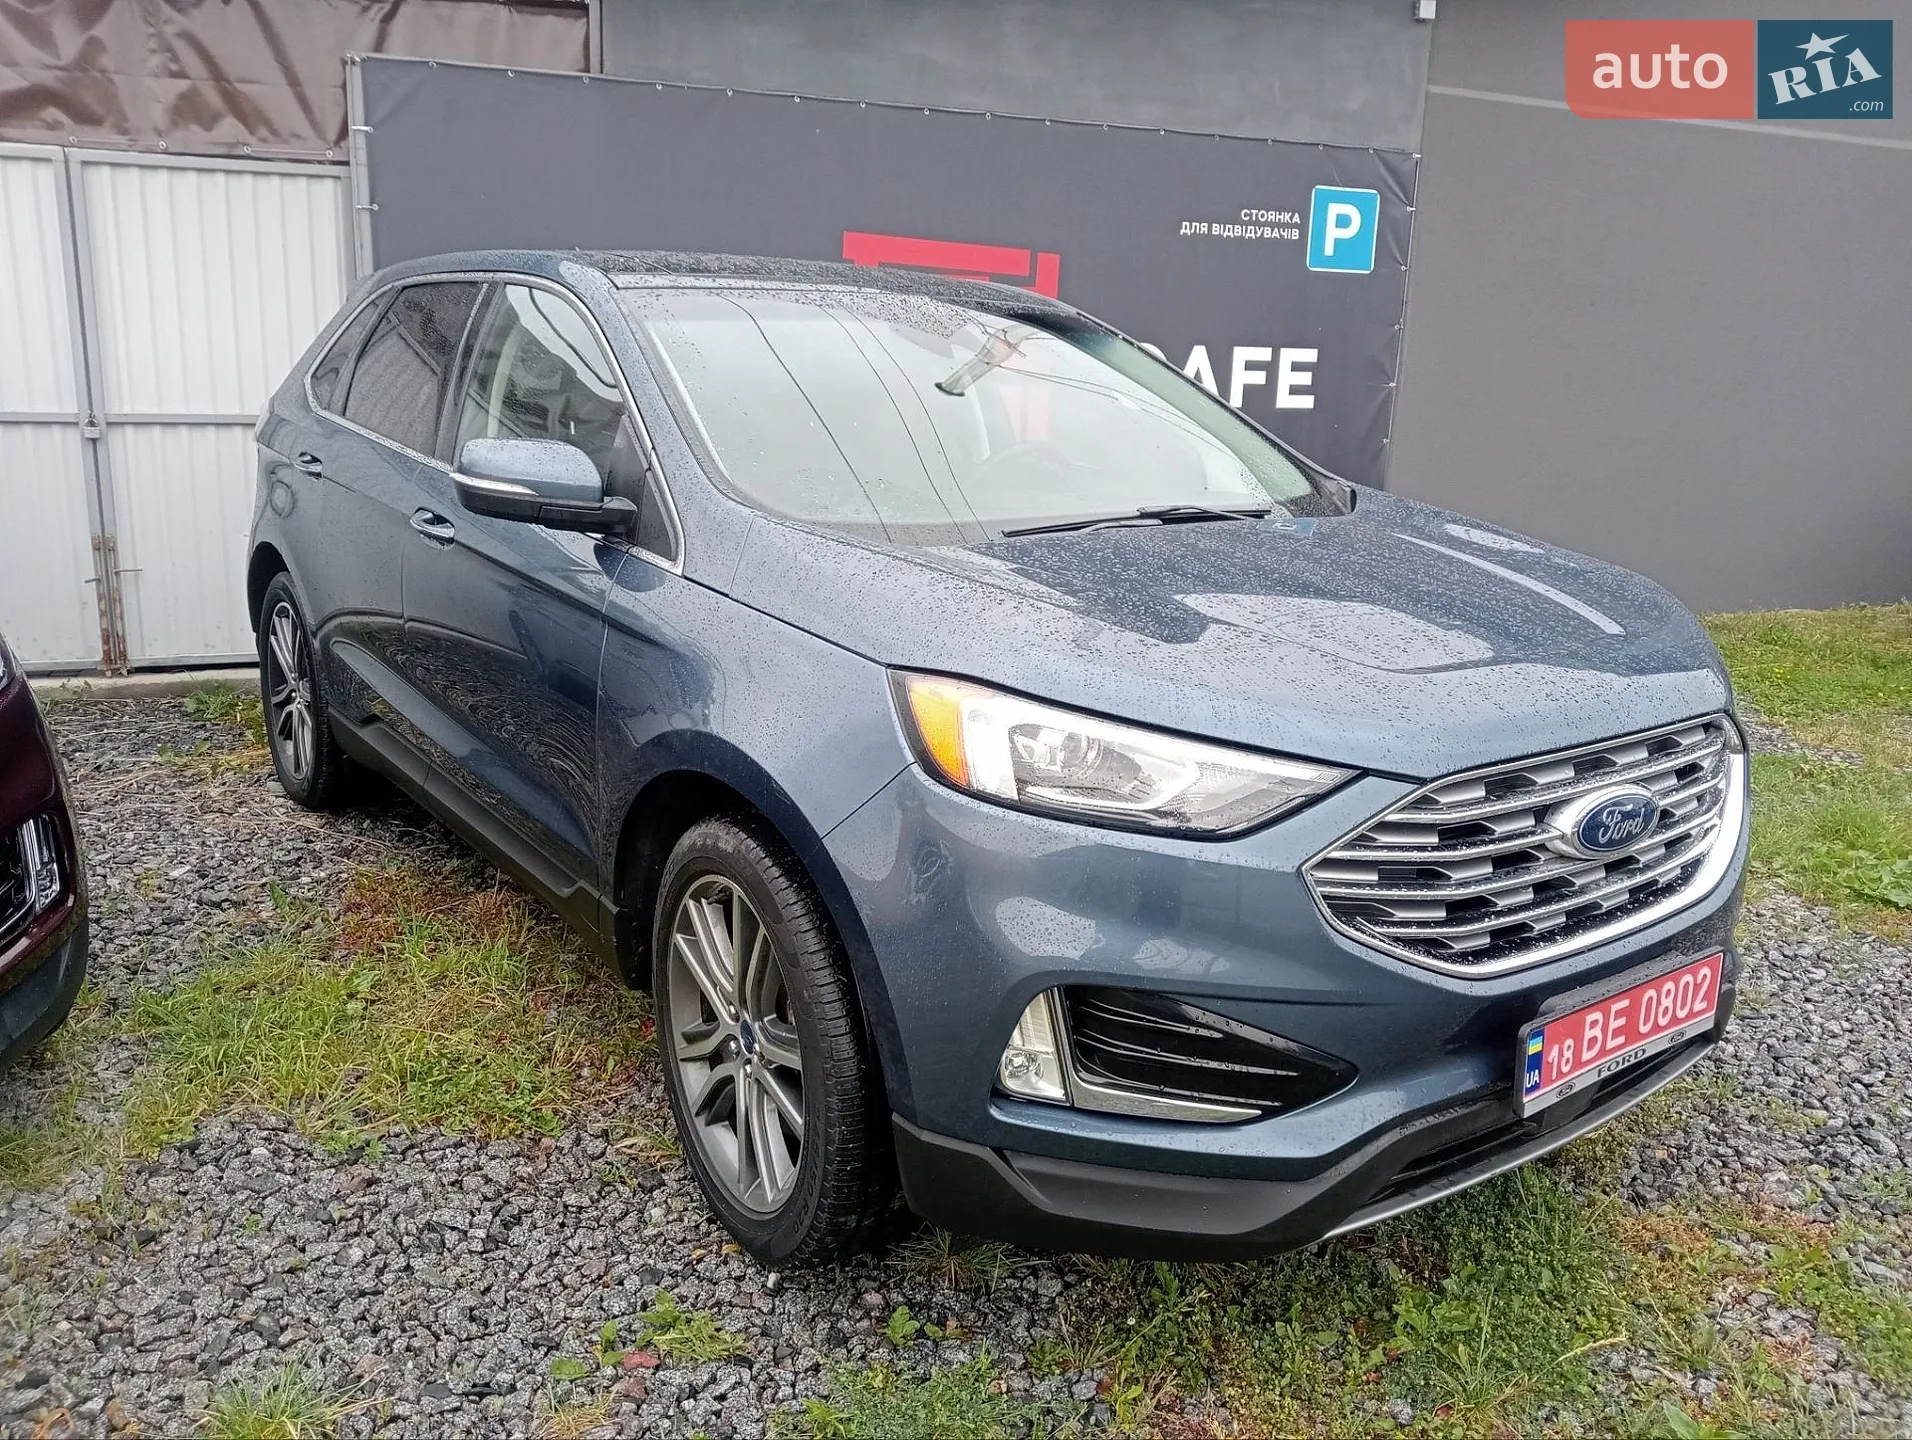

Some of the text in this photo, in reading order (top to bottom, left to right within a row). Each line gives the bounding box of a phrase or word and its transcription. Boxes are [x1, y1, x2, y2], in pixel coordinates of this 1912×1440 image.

[1180, 221, 1300, 240] ДЛЯ ВІДВІДУВАЧІВ
[1240, 208, 1301, 224] СТОЯНКА
[1323, 202, 1362, 257] P
[1140, 342, 1319, 409] AFE
[1598, 802, 1646, 845] Ford
[1547, 966, 1713, 1081] 18 BE 0802
[1526, 1071, 1541, 1090] UA
[1596, 1047, 1648, 1078] FORD
